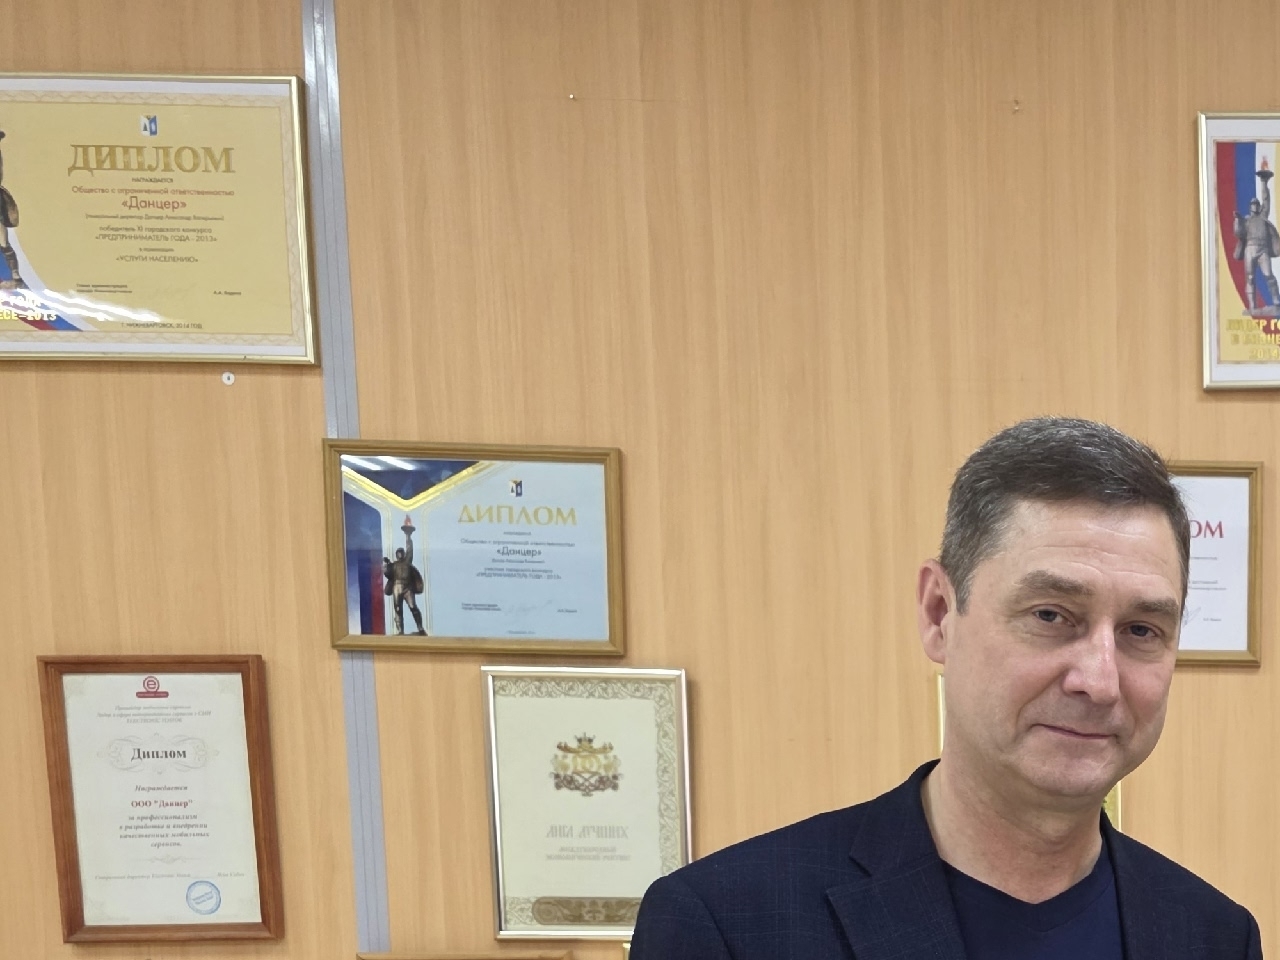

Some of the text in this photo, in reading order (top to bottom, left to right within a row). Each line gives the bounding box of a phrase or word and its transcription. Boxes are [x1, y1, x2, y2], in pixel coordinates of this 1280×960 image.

[67, 144, 237, 177] ДИПЛОМ
[121, 196, 187, 212] «Данцер»
[458, 504, 578, 526] ДИПЛОМ
[131, 748, 187, 763] Диплом
[131, 800, 152, 808] ООО
